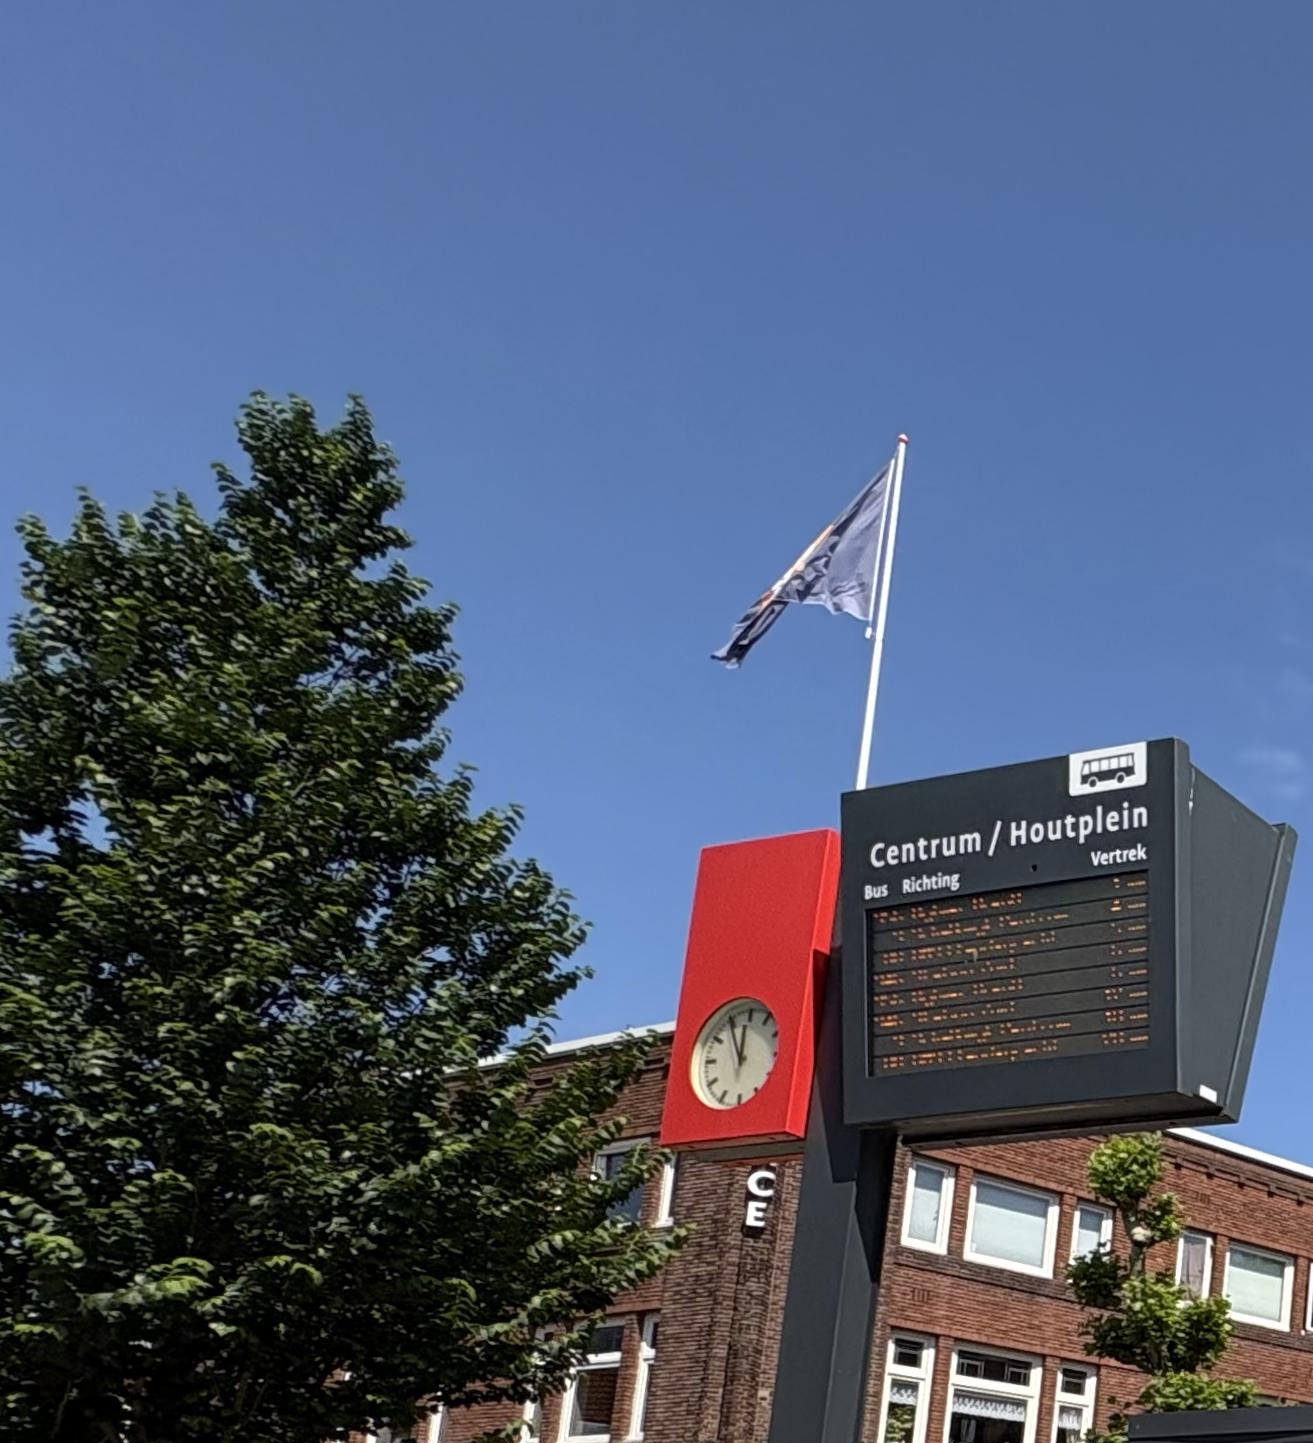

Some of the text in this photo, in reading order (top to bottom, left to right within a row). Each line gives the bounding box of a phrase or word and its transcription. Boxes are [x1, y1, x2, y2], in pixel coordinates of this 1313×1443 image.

[870, 832, 981, 867] Centrum
[1010, 802, 1148, 846] Houtplein
[1091, 844, 1147, 866] Vertrek
[864, 872, 960, 900] Bus Richting
